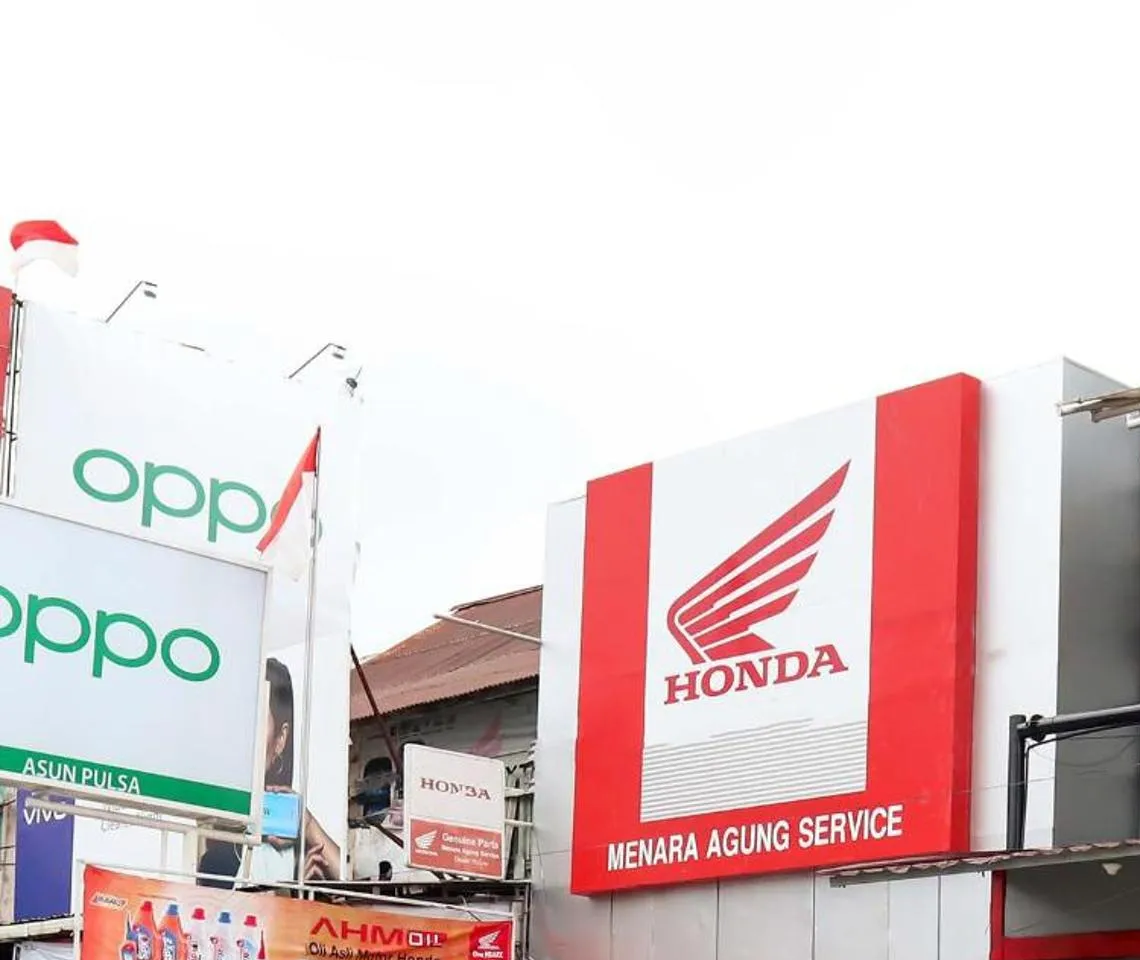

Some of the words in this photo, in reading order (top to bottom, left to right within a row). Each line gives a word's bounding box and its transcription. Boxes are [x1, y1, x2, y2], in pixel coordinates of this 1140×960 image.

[664, 644, 849, 705] HONDA
[22, 756, 77, 783] ASUN
[82, 769, 142, 796] PULSA
[607, 833, 699, 872] MENARA
[706, 821, 790, 859] AGUNG
[798, 804, 905, 844] SERVICE
[329, 945, 354, 960] Asli
